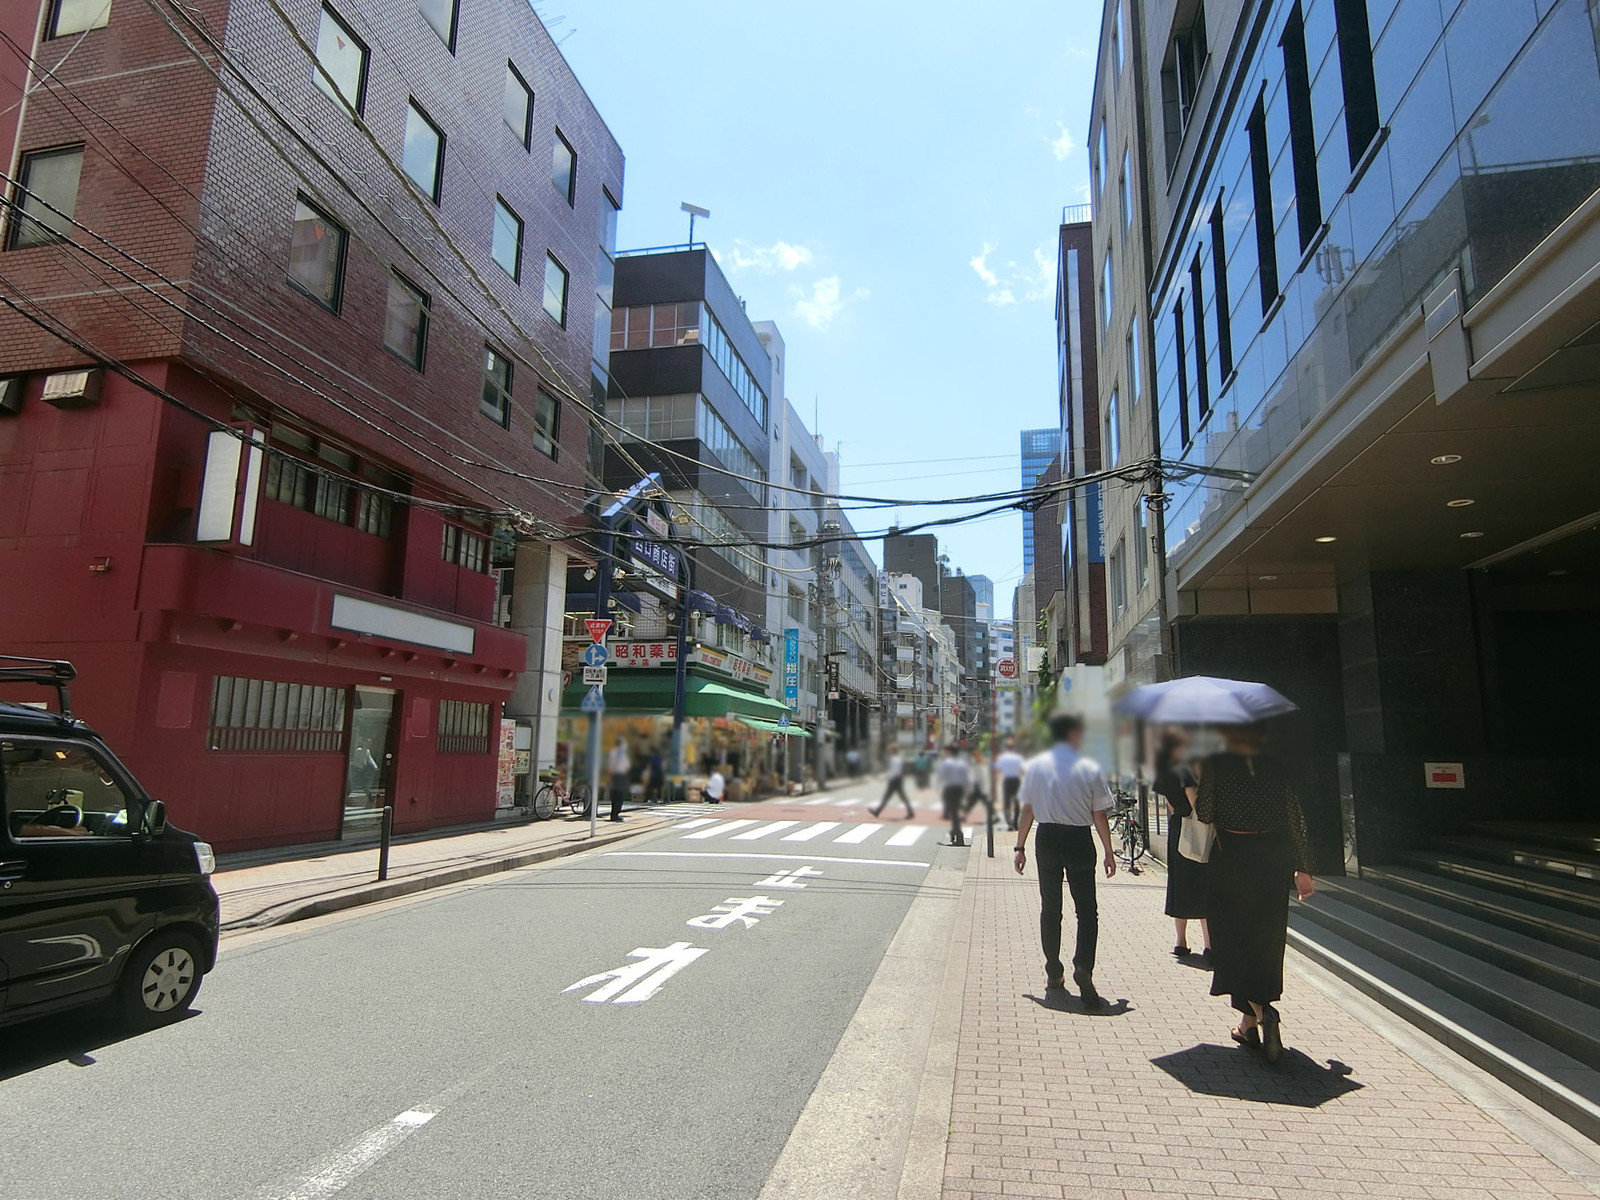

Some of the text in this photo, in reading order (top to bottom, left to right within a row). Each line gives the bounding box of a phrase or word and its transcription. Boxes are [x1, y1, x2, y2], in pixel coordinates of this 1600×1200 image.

[615, 644, 678, 658] 昭和薬品
[559, 865, 824, 1005] 止まれ
